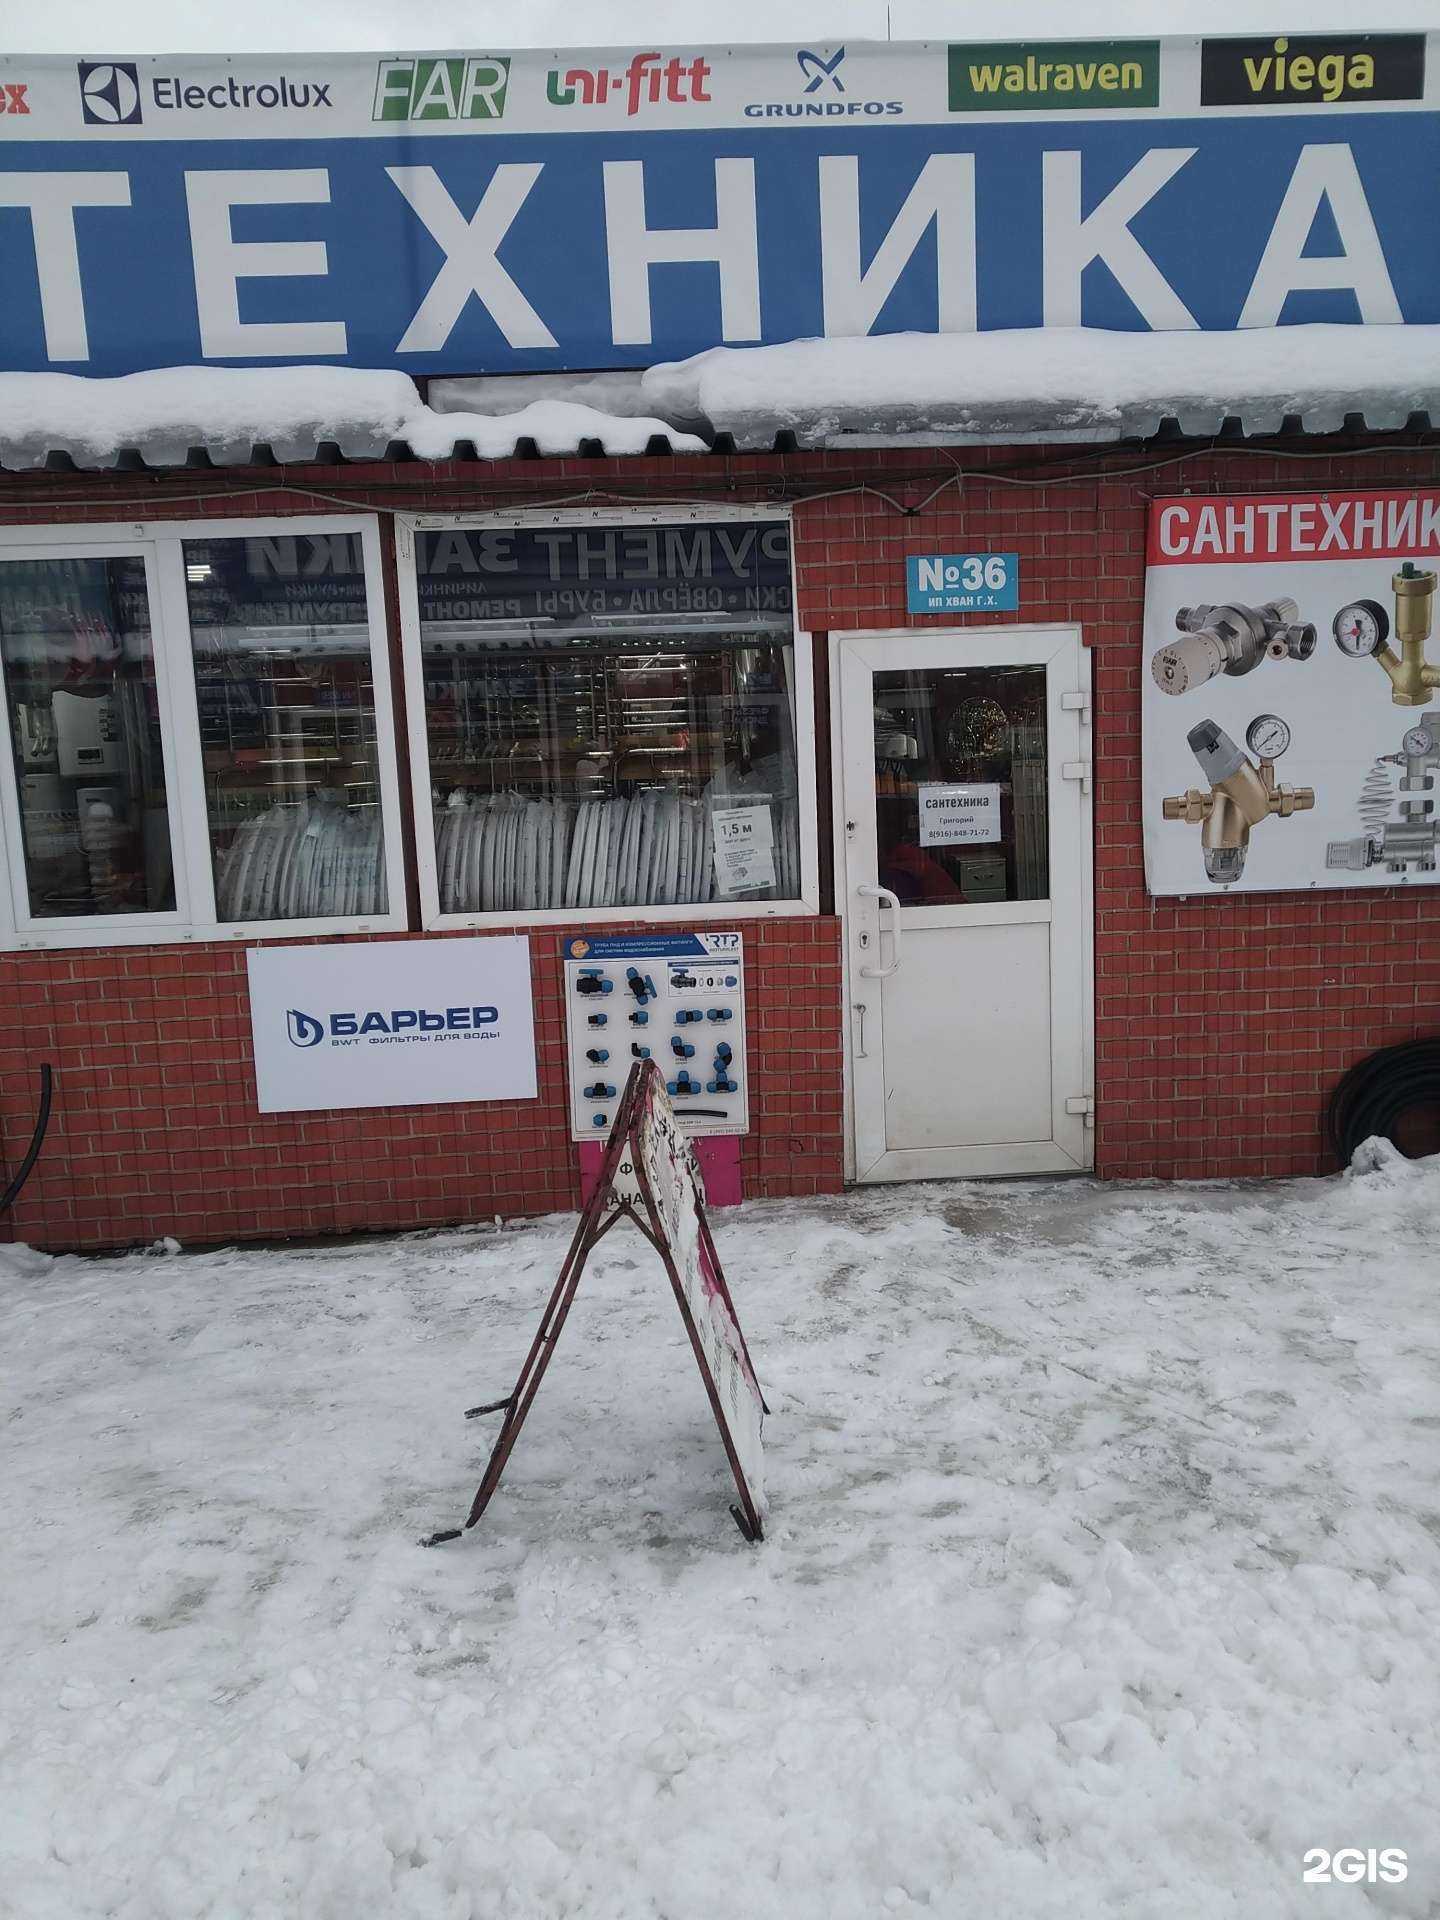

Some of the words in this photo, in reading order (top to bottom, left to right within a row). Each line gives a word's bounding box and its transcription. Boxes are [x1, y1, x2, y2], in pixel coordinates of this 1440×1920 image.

[546, 53, 712, 116] uni-fitt
[969, 54, 1143, 93] walraven
[1243, 37, 1375, 102] viega
[153, 76, 332, 110] Electrolux
[372, 57, 511, 121] FAR
[744, 100, 904, 118] GRUNDFOS
[0, 143, 1405, 361] ТЕХНИКА
[1160, 498, 1440, 556] САНТЕХНИК
[918, 557, 1007, 592] №36
[928, 597, 943, 607] ИП
[946, 596, 973, 606] ХВАН
[925, 797, 989, 809] сантехника
[721, 823, 740, 838] 1,5
[940, 816, 975, 825] Григорий
[709, 934, 739, 947] RTP
[329, 1006, 499, 1036] БАРЬЕР
[331, 1038, 360, 1047] BWT
